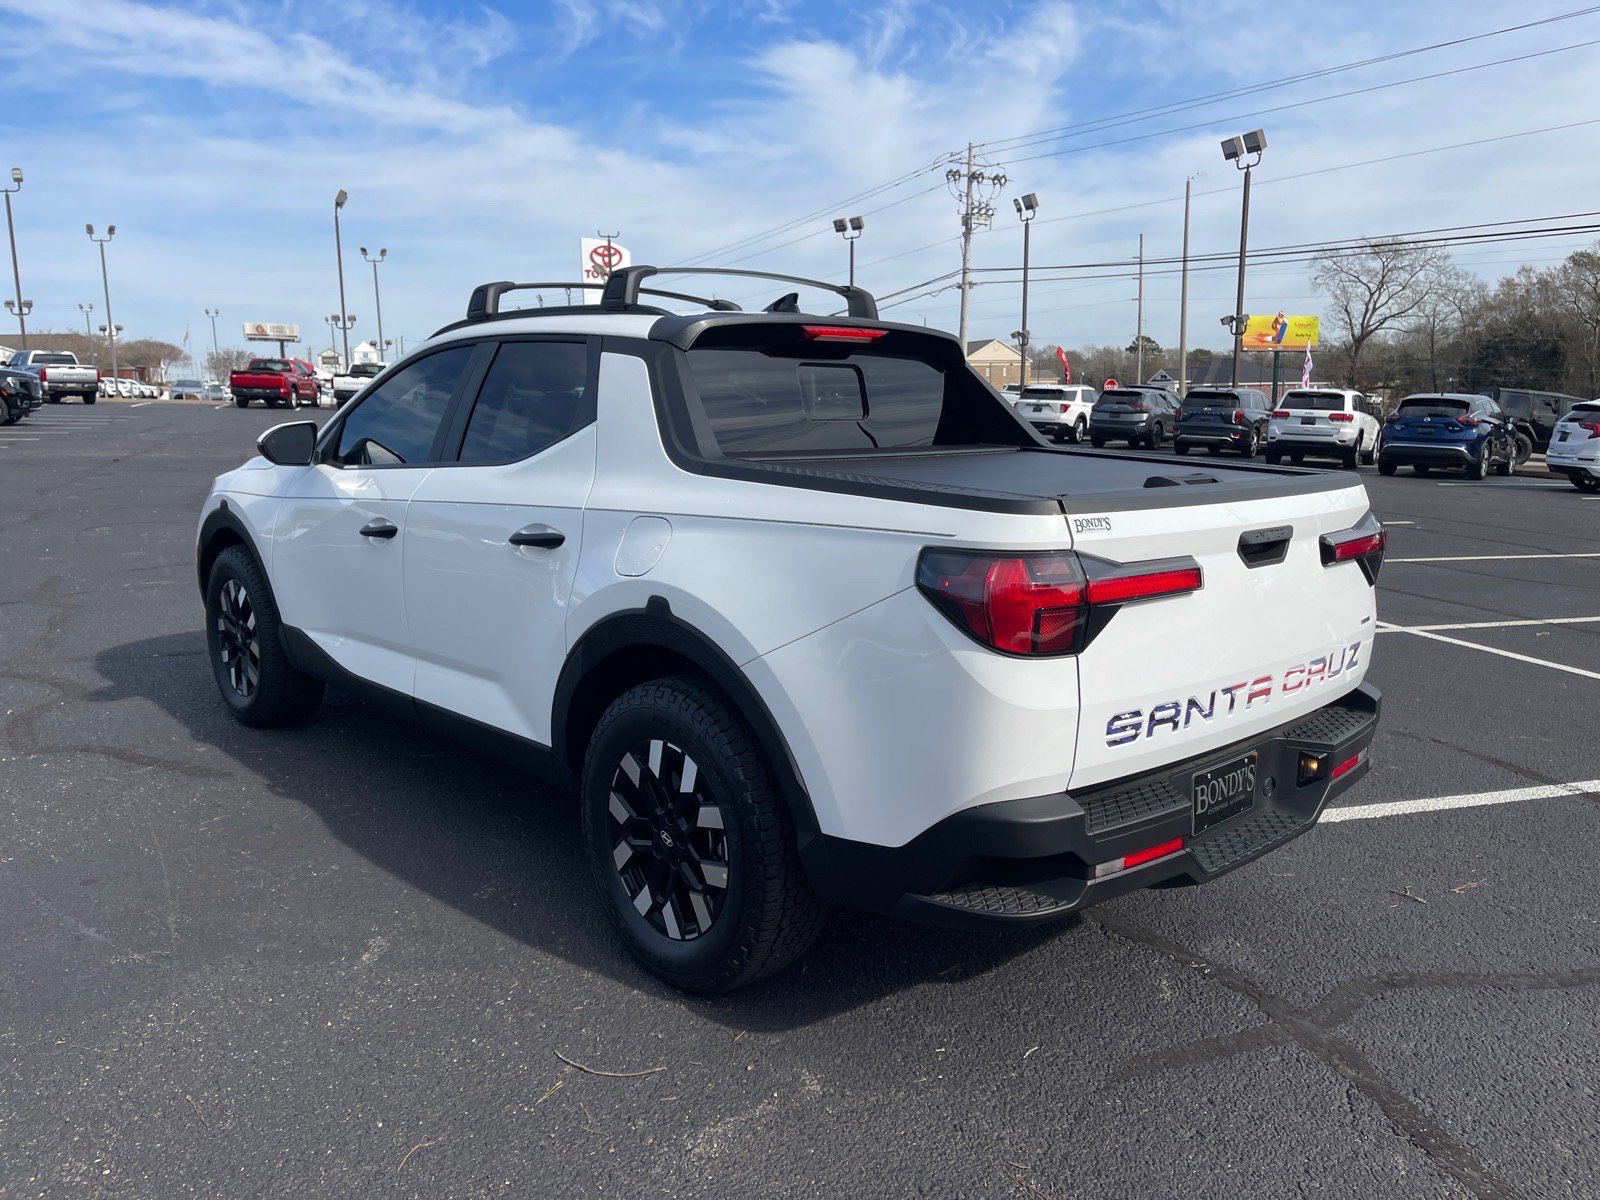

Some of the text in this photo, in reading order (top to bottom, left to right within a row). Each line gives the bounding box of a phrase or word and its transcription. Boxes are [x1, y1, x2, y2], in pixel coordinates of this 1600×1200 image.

[1074, 517, 1111, 533] BONDY'S
[1105, 641, 1362, 749] SANTA CRUZ
[1195, 764, 1255, 815] BONDY'S
